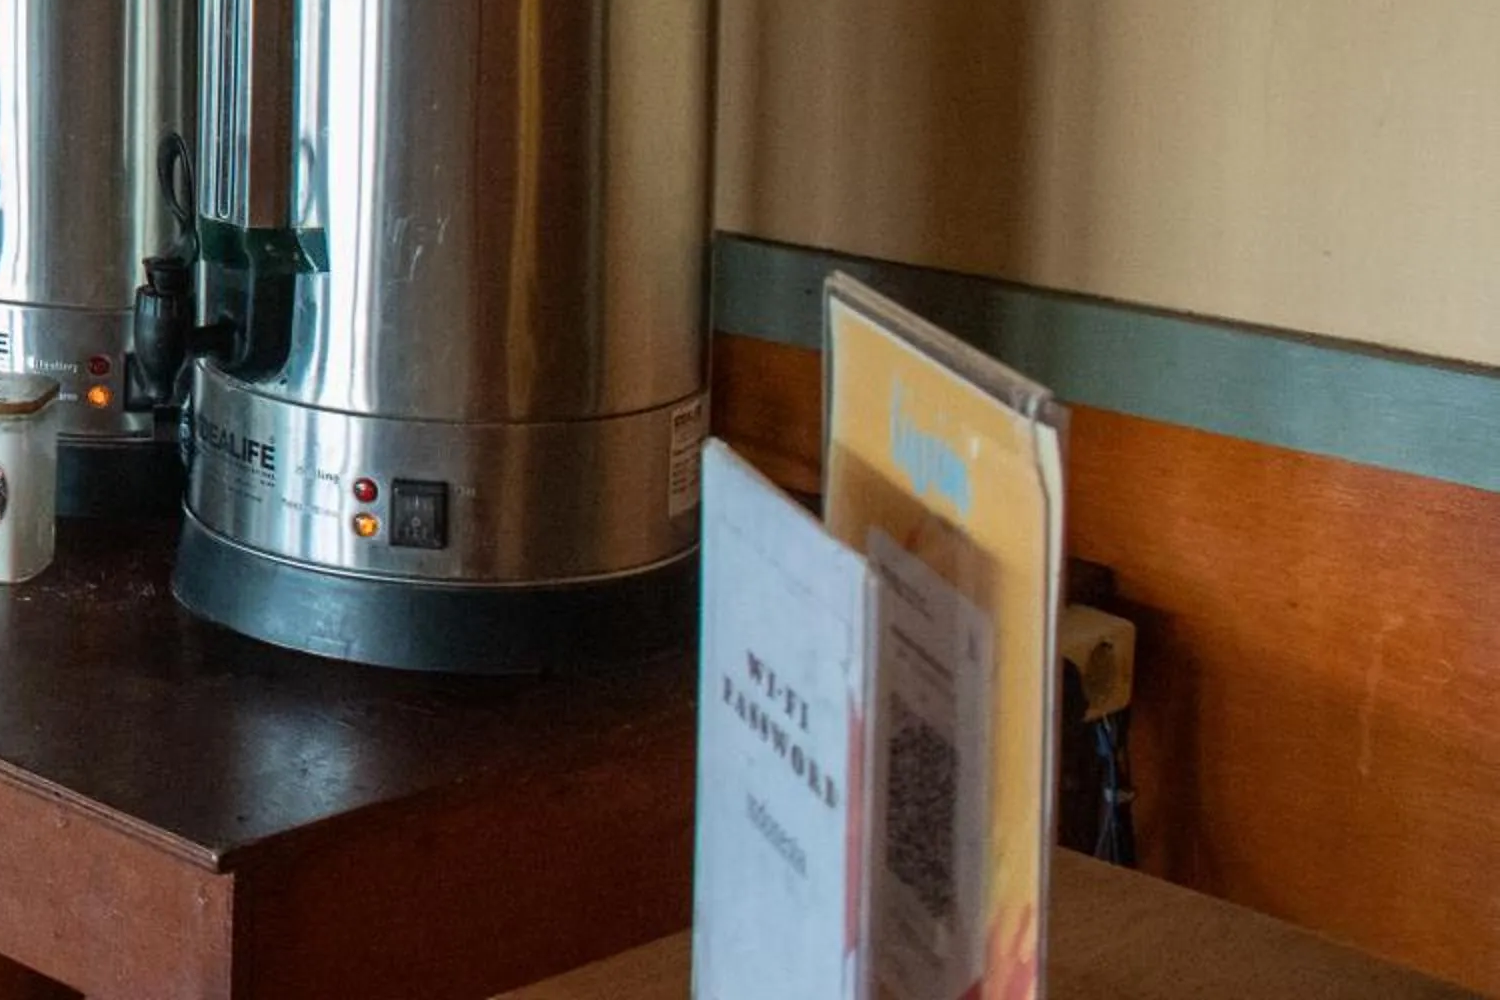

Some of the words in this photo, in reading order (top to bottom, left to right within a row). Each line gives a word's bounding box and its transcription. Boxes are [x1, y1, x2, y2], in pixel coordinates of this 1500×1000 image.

[199, 412, 276, 471] DEALIFE
[746, 648, 809, 732] WI-FI
[723, 673, 838, 809] PASSWORD
